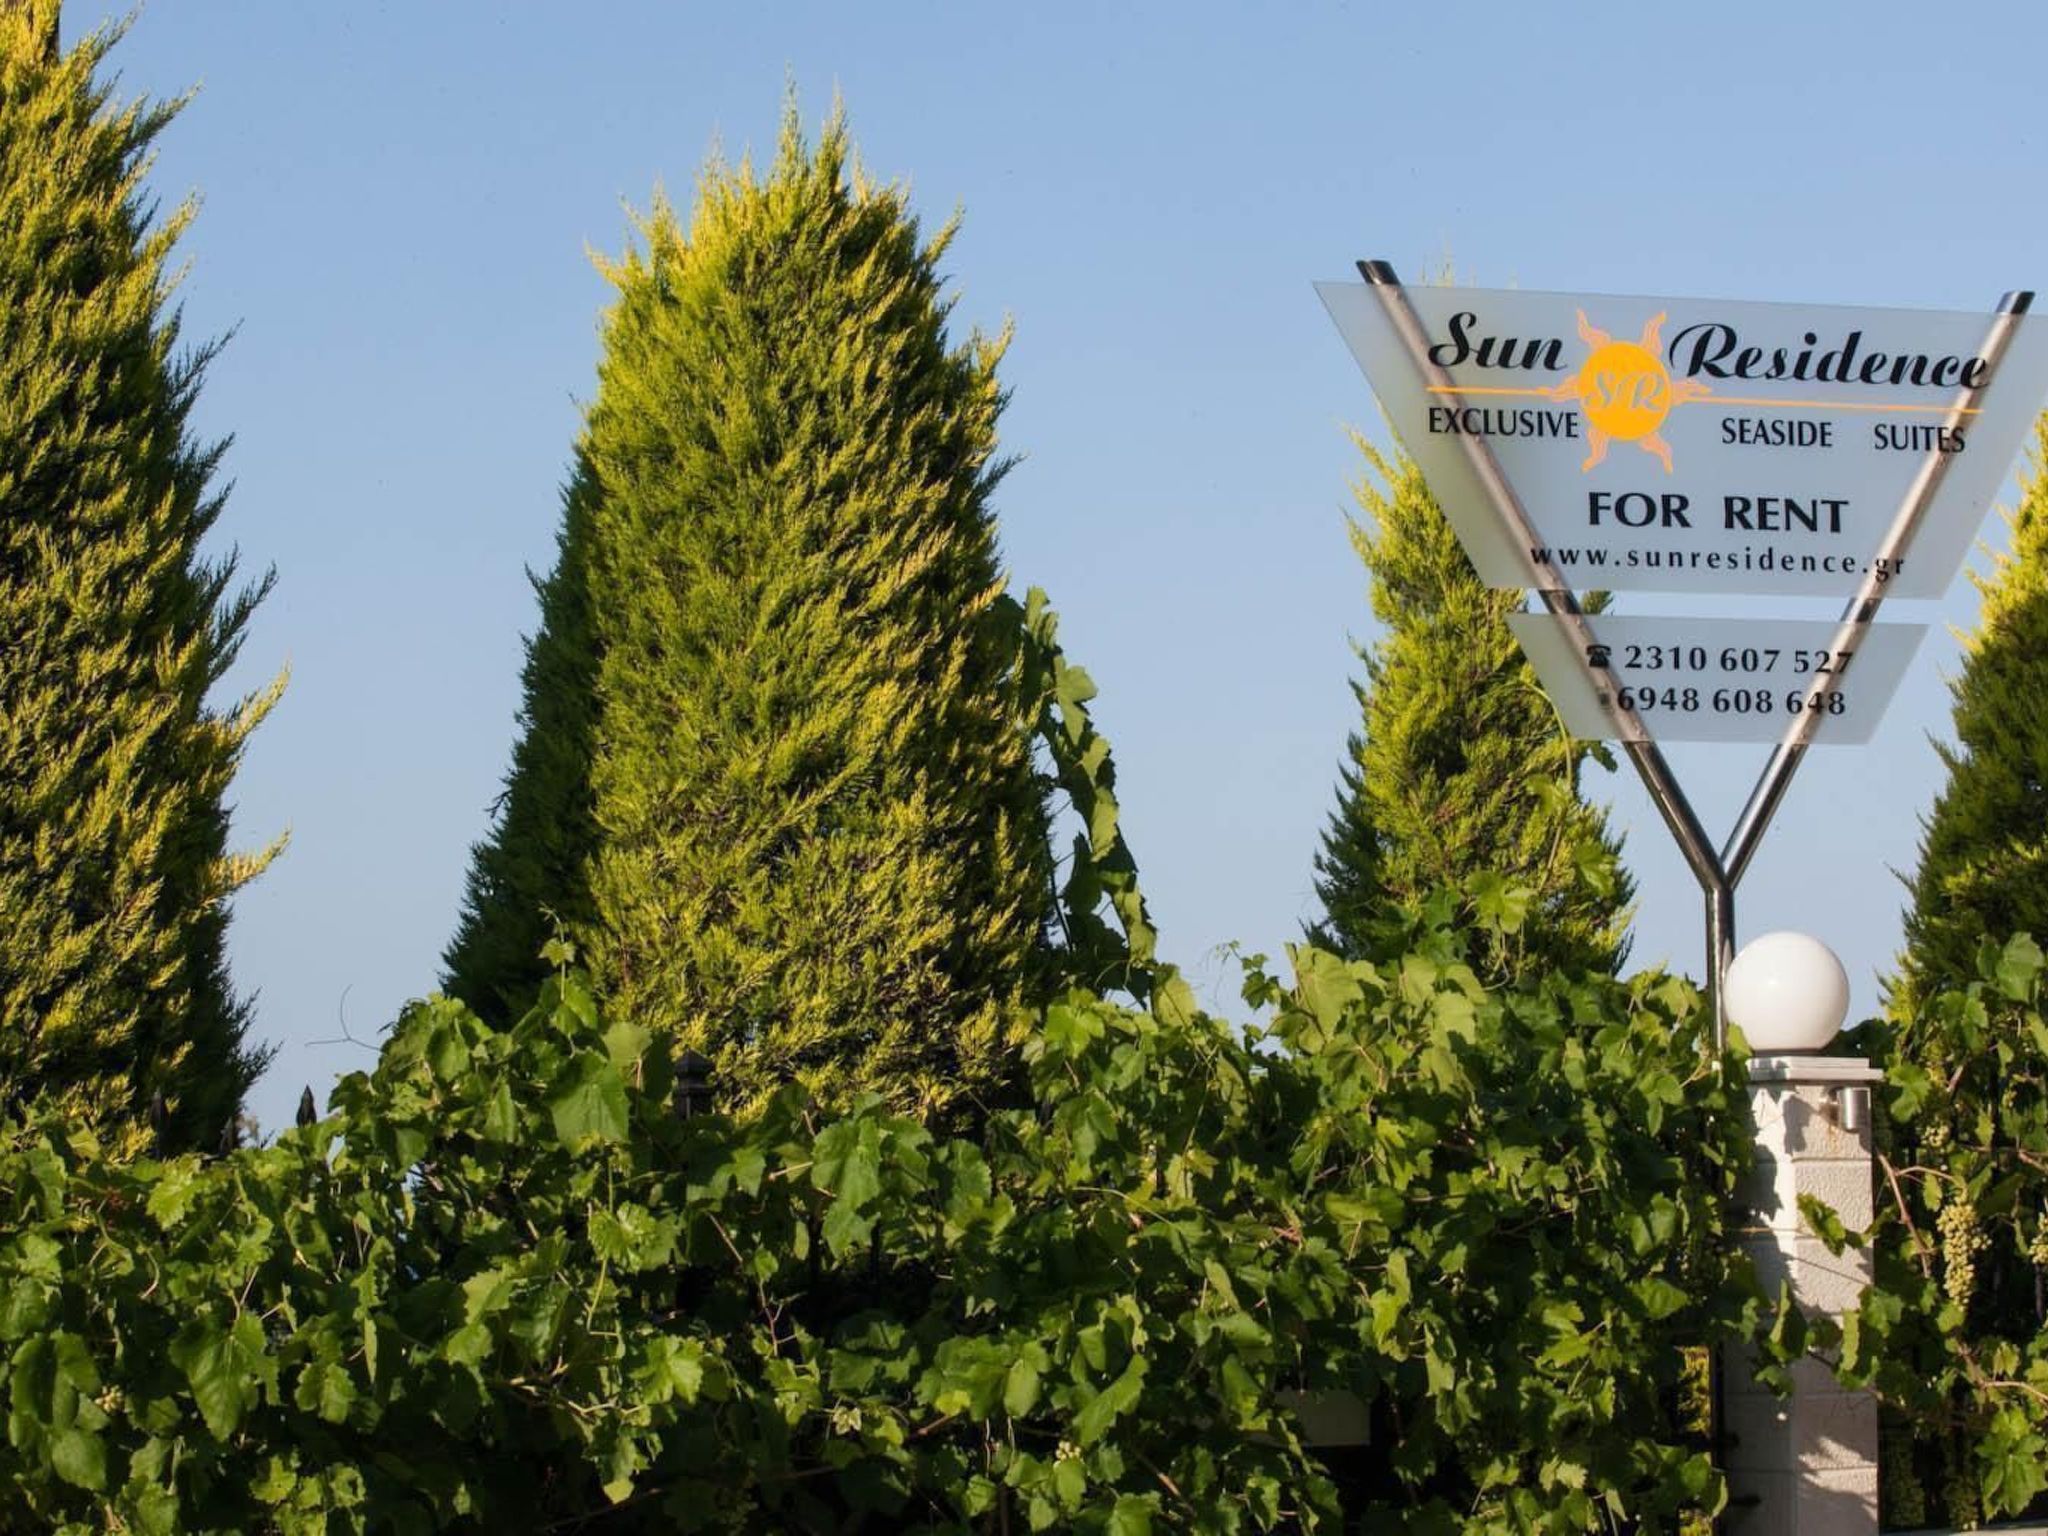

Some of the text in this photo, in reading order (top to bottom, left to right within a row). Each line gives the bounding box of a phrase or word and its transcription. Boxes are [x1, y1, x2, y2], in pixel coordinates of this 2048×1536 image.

[1427, 311, 1989, 390] Sun Residence
[1428, 407, 1966, 454] EXCLUSIVE SEASIDE SUITES
[1588, 492, 1850, 534] FOR RENT
[1530, 546, 1907, 582] www.sunresidence.gr
[1624, 645, 1854, 674] 2310 607 527
[1617, 686, 1846, 716] 6948 608 648
